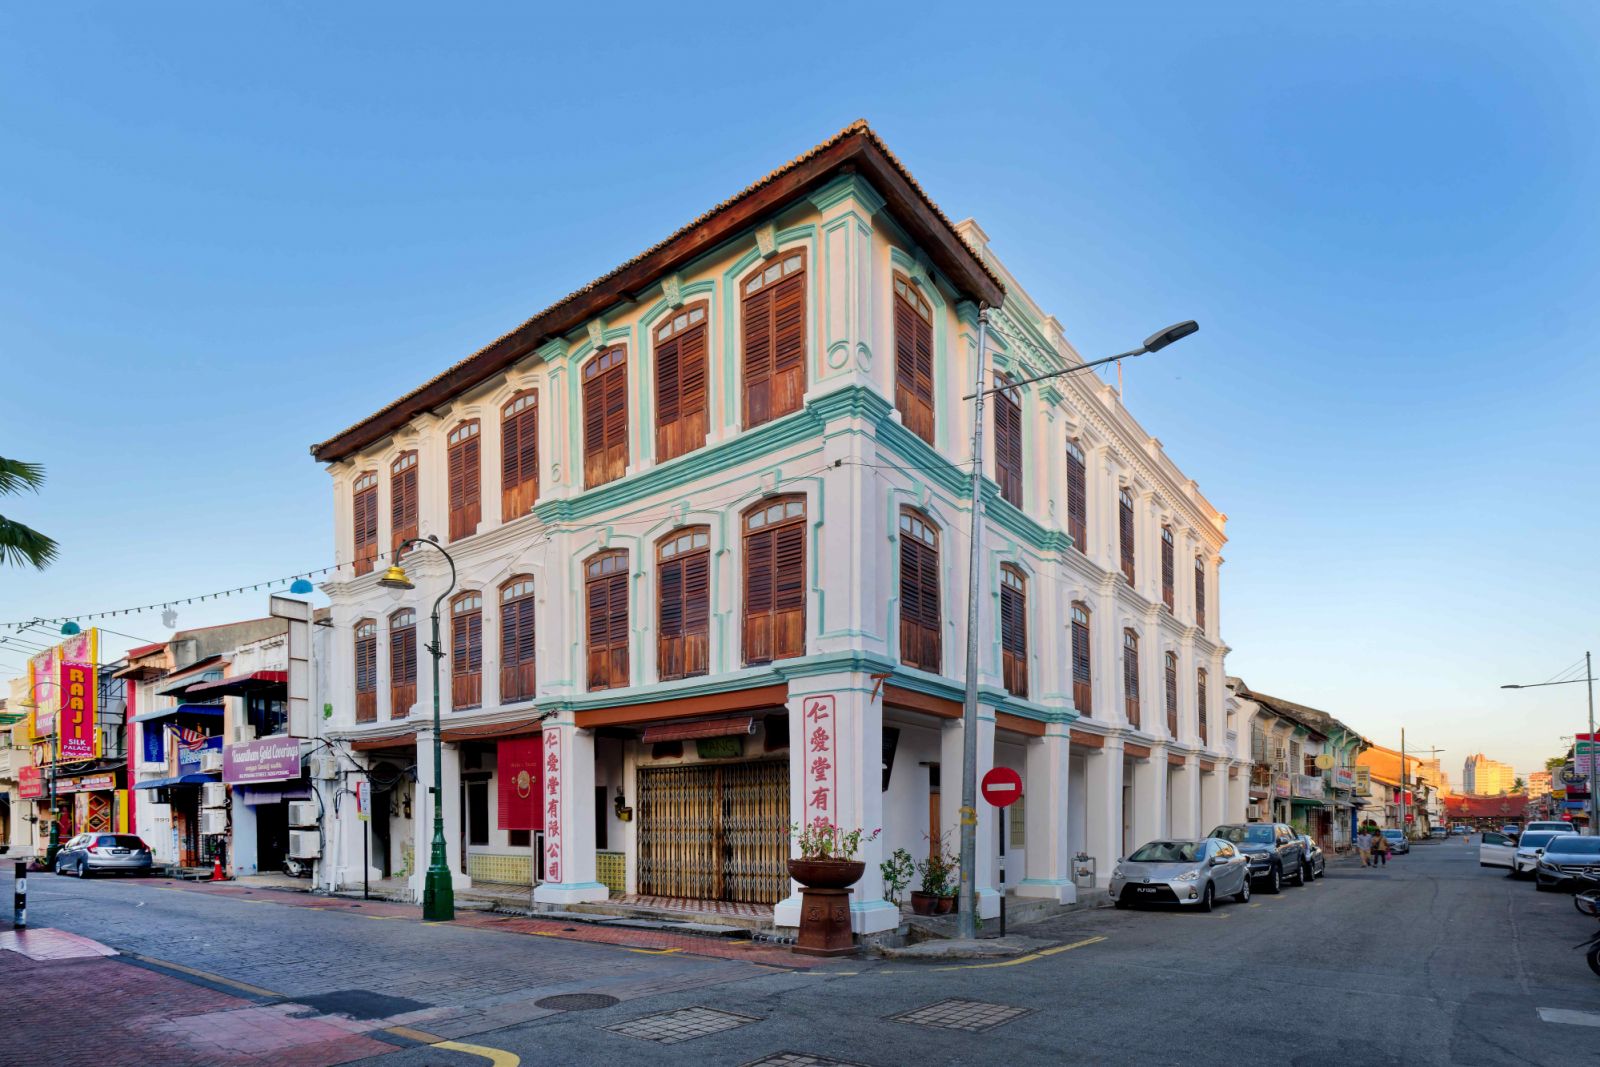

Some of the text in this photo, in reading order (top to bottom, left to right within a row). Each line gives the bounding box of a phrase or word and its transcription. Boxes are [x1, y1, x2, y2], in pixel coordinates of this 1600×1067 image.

[70, 668, 84, 738] RAAJI
[68, 738, 86, 746] SILK
[260, 745, 272, 763] Gold
[272, 743, 299, 761] Coverings
[545, 732, 559, 880] 仁愛堂有限公司
